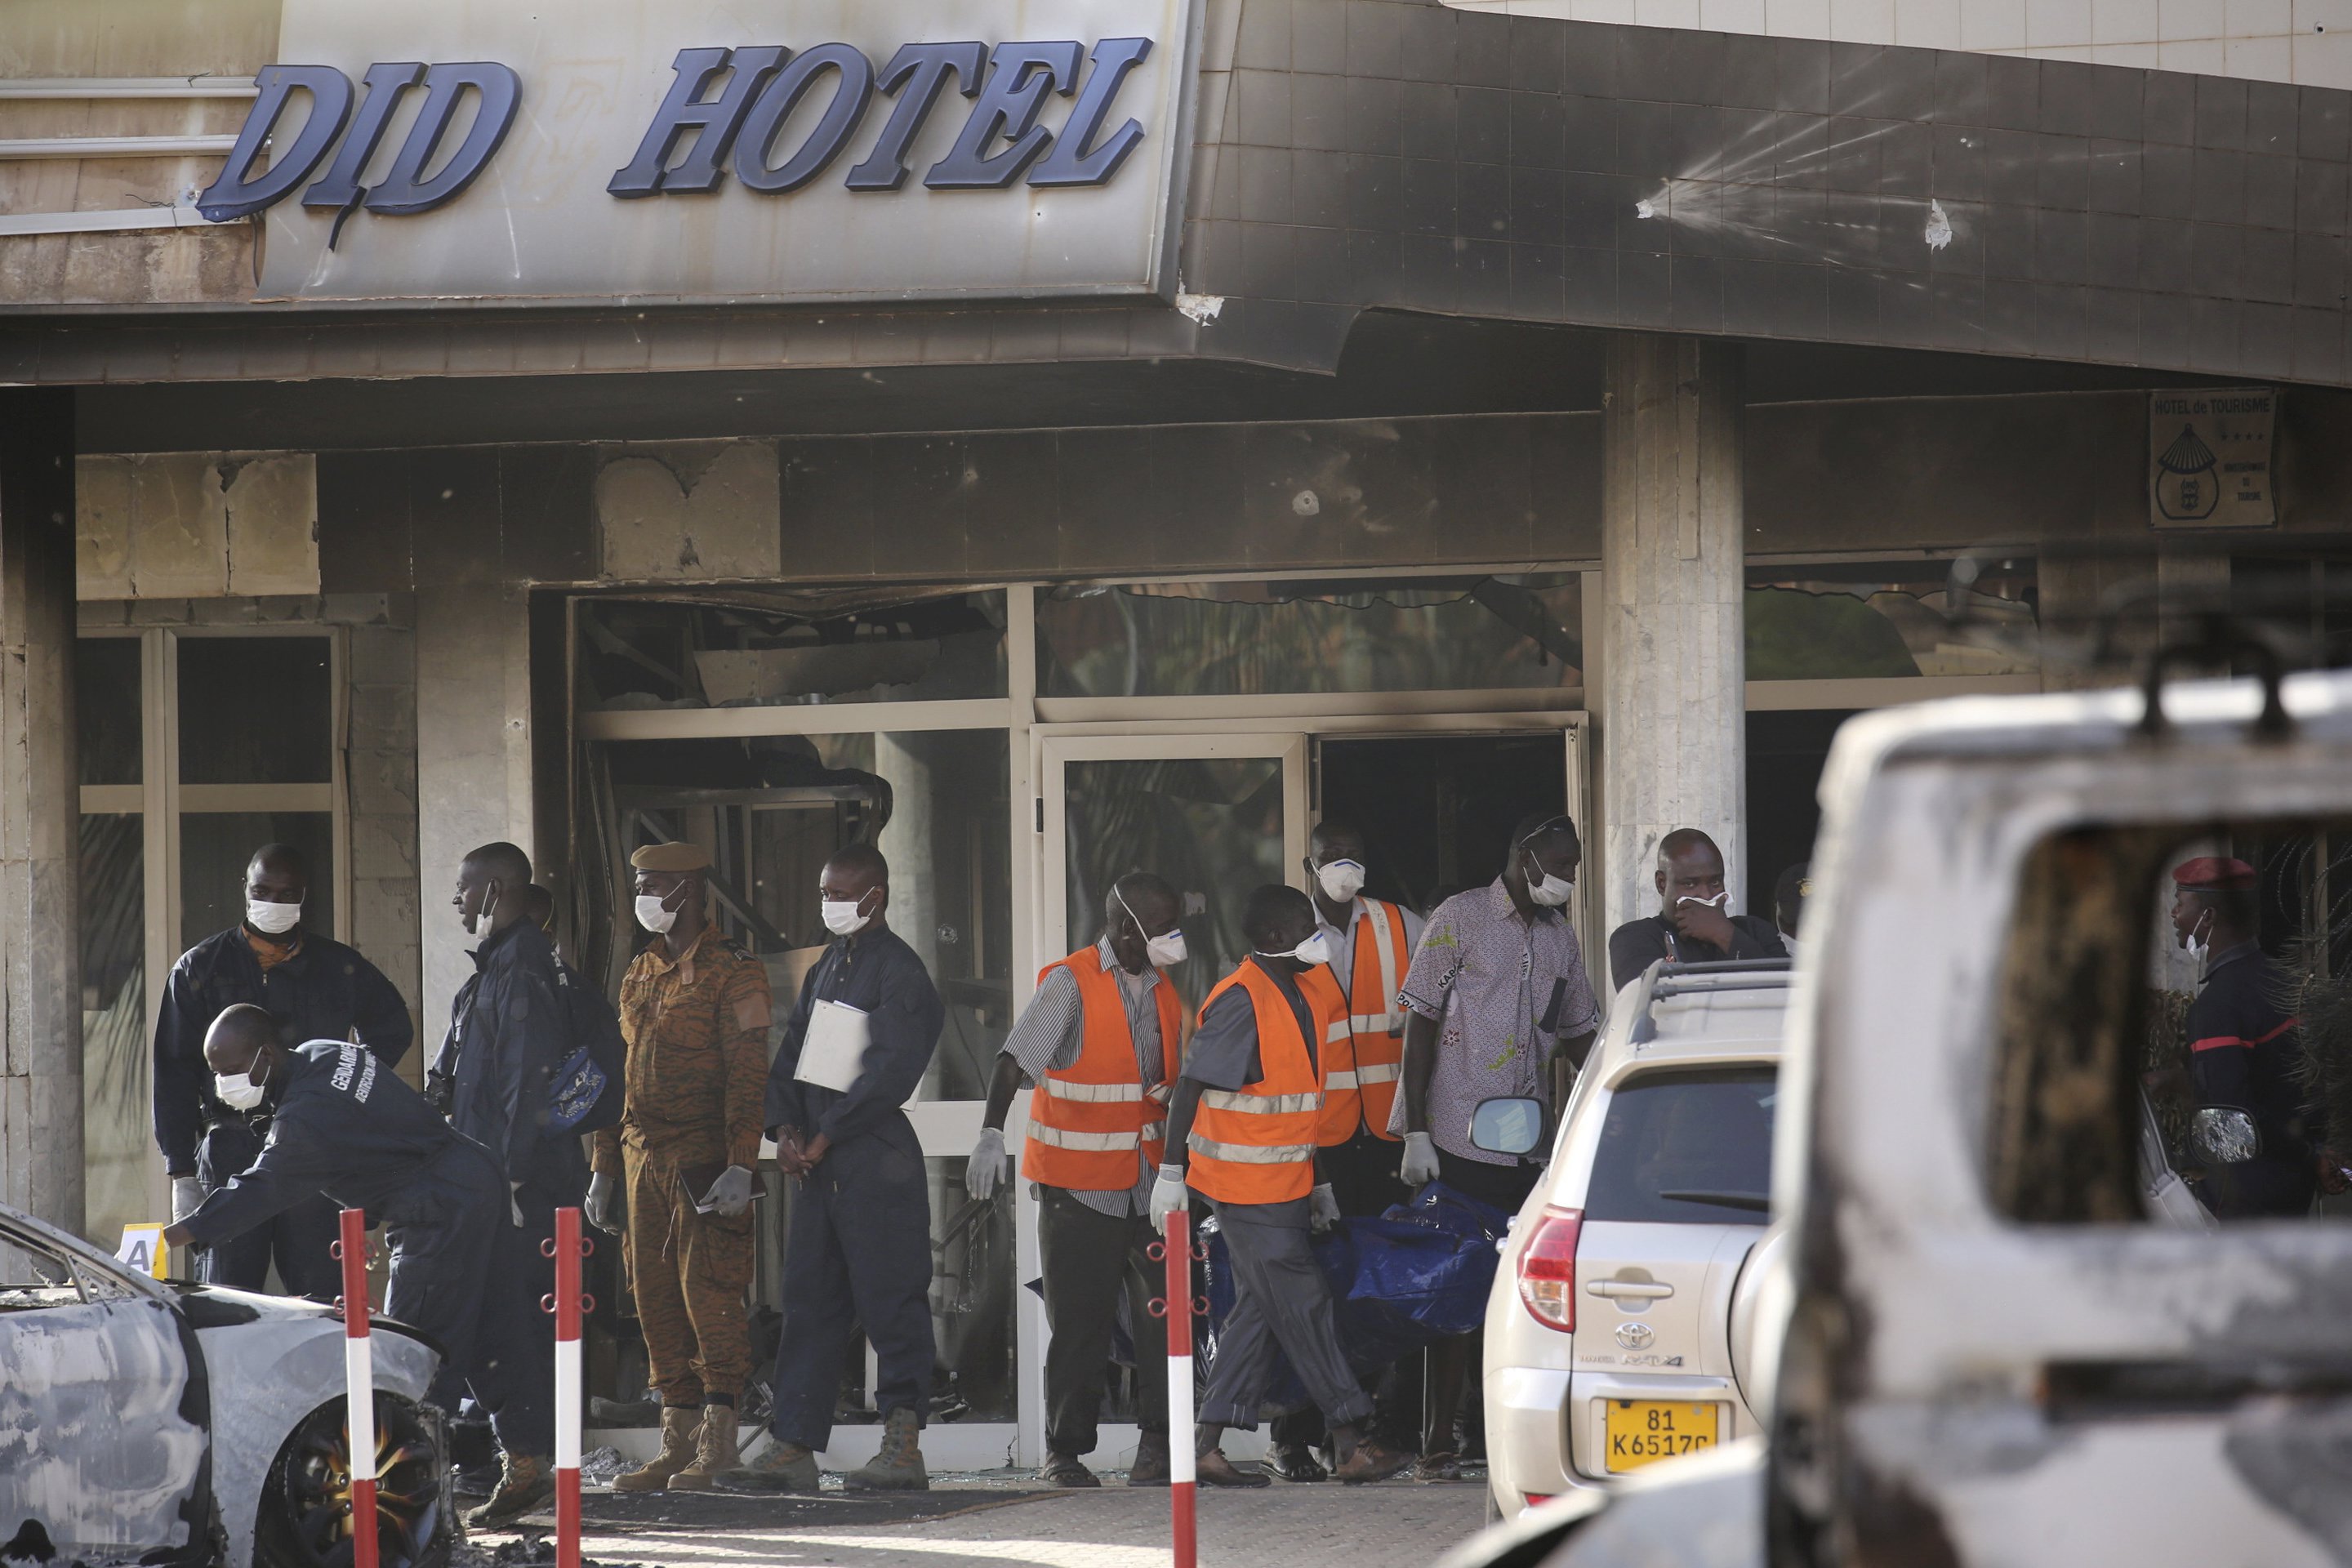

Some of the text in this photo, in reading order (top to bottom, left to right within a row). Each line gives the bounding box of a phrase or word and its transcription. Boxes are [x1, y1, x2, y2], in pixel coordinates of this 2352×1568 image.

[196, 37, 1154, 224] DID HOTEL
[2155, 397, 2270, 415] HOTEL de TOURISME
[125, 1240, 150, 1272] A
[1647, 1410, 1675, 1431] 81
